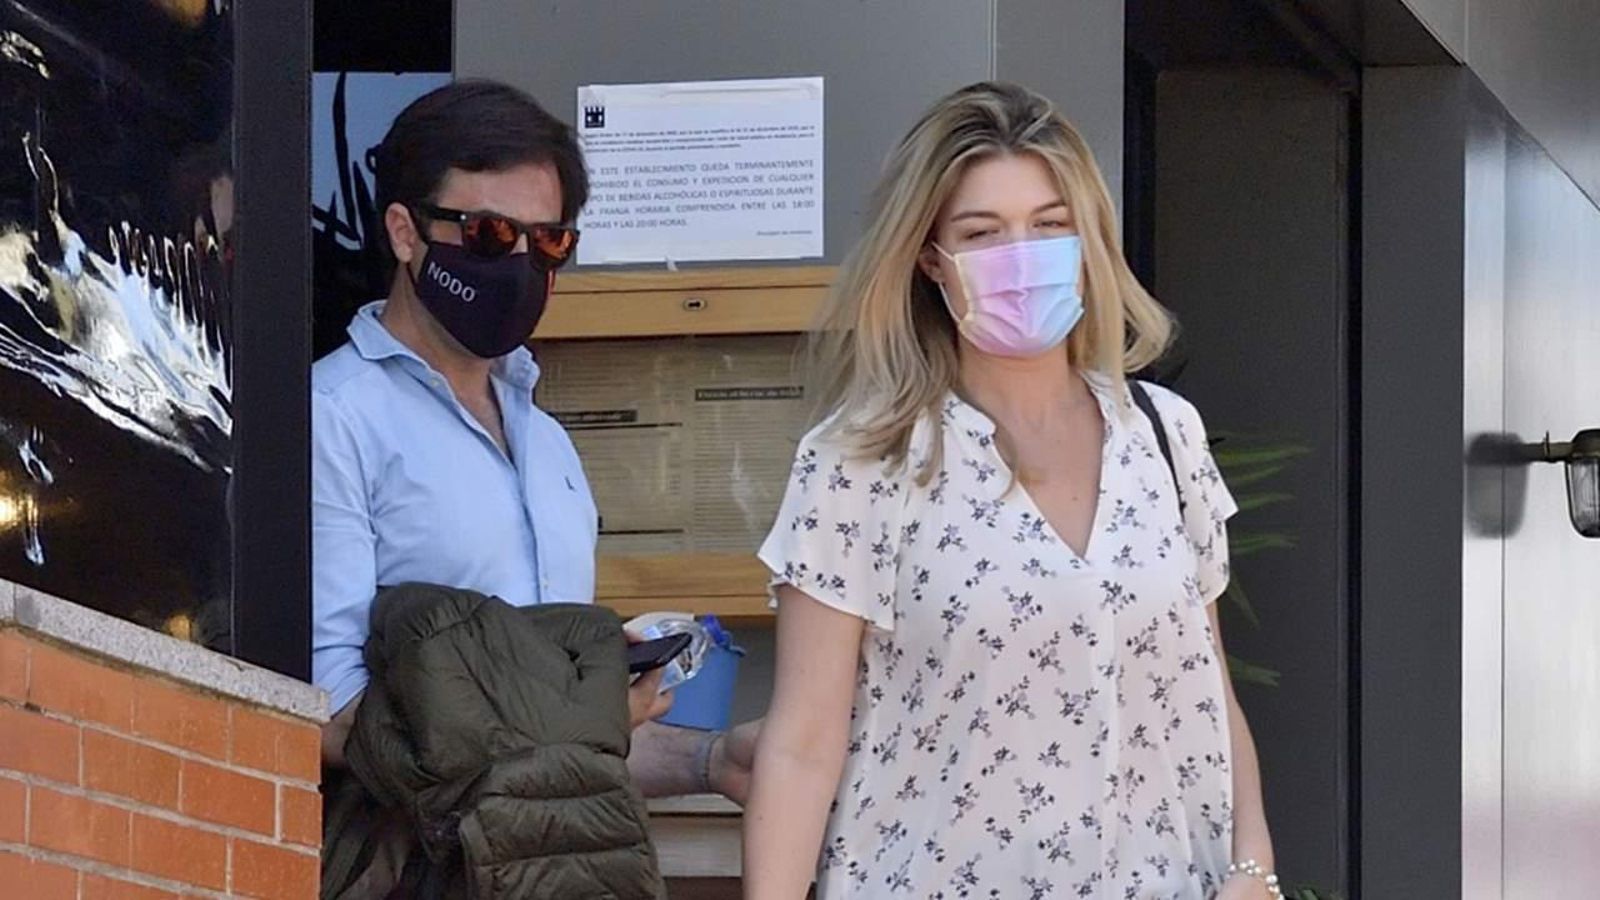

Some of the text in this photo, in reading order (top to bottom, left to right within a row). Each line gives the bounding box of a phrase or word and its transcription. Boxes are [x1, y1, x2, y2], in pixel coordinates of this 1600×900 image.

[600, 167, 618, 175] ESTE
[624, 164, 696, 174] ESTABLECIMIENTO
[701, 163, 729, 172] QUEDA
[735, 160, 813, 170] TERMINANTEMENTE
[633, 180, 641, 189] EL
[646, 178, 688, 188] CONSUMO
[753, 174, 763, 183] DE
[768, 173, 813, 182] CUALQUIER
[606, 193, 615, 202] DE
[619, 192, 652, 201] BEBIDAS
[719, 188, 774, 198] ESPIRITUOSAS
[776, 186, 813, 195] DURANTE
[600, 206, 629, 215] FRANJA
[635, 205, 671, 214] HORARIA
[676, 203, 735, 212] COMPRENDIDA
[741, 201, 766, 210] ENTRE
[772, 201, 786, 210] LAS
[583, 221, 612, 229] HORAS
[621, 220, 633, 228] LAS
[427, 260, 475, 301] NODO
